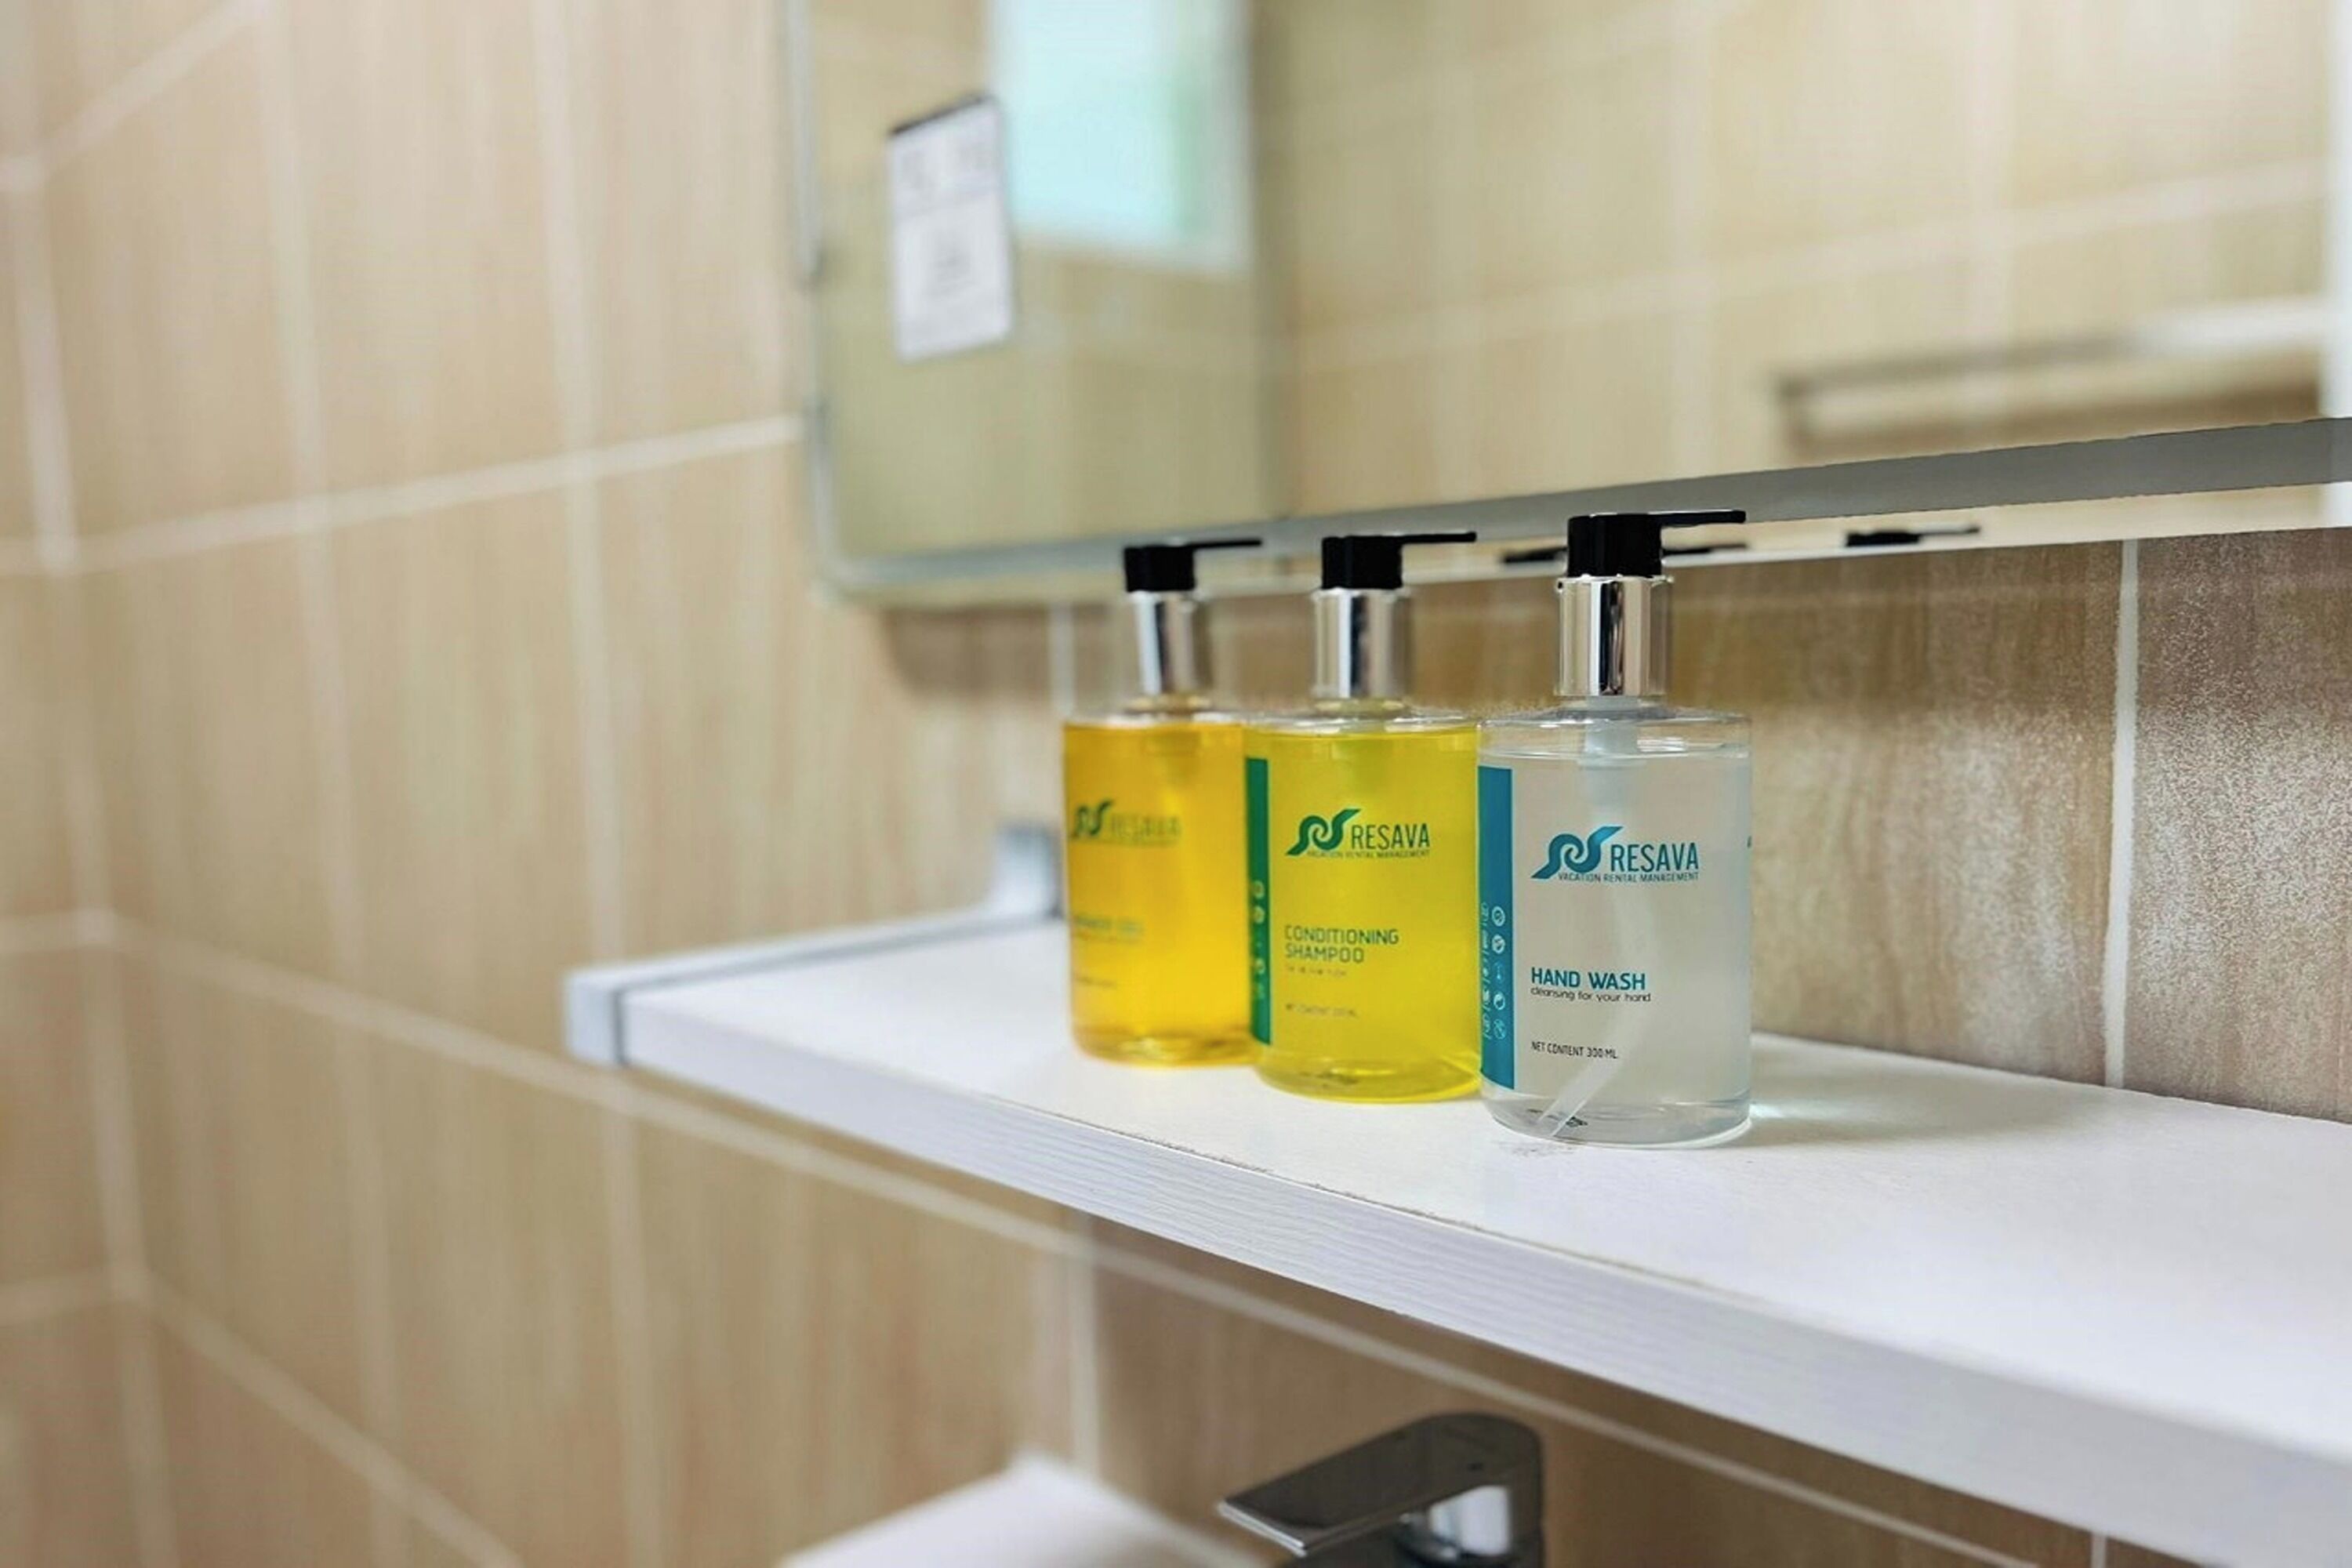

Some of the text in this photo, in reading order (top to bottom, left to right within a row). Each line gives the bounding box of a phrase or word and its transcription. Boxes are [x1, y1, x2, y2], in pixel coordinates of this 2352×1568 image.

[1352, 823, 1431, 851] RESAVA
[1610, 842, 1699, 873] RESAVA
[1558, 872, 1700, 883] VACATION RENTAL MANAGEMENT
[1284, 924, 1399, 946] CONDITIONING
[1285, 942, 1365, 964] SHAMPOO
[1531, 967, 1646, 990] HAND WASH
[1530, 987, 1651, 1002] cleansing for your hand
[1531, 1041, 1618, 1059] NET CONTENT 300 ML
